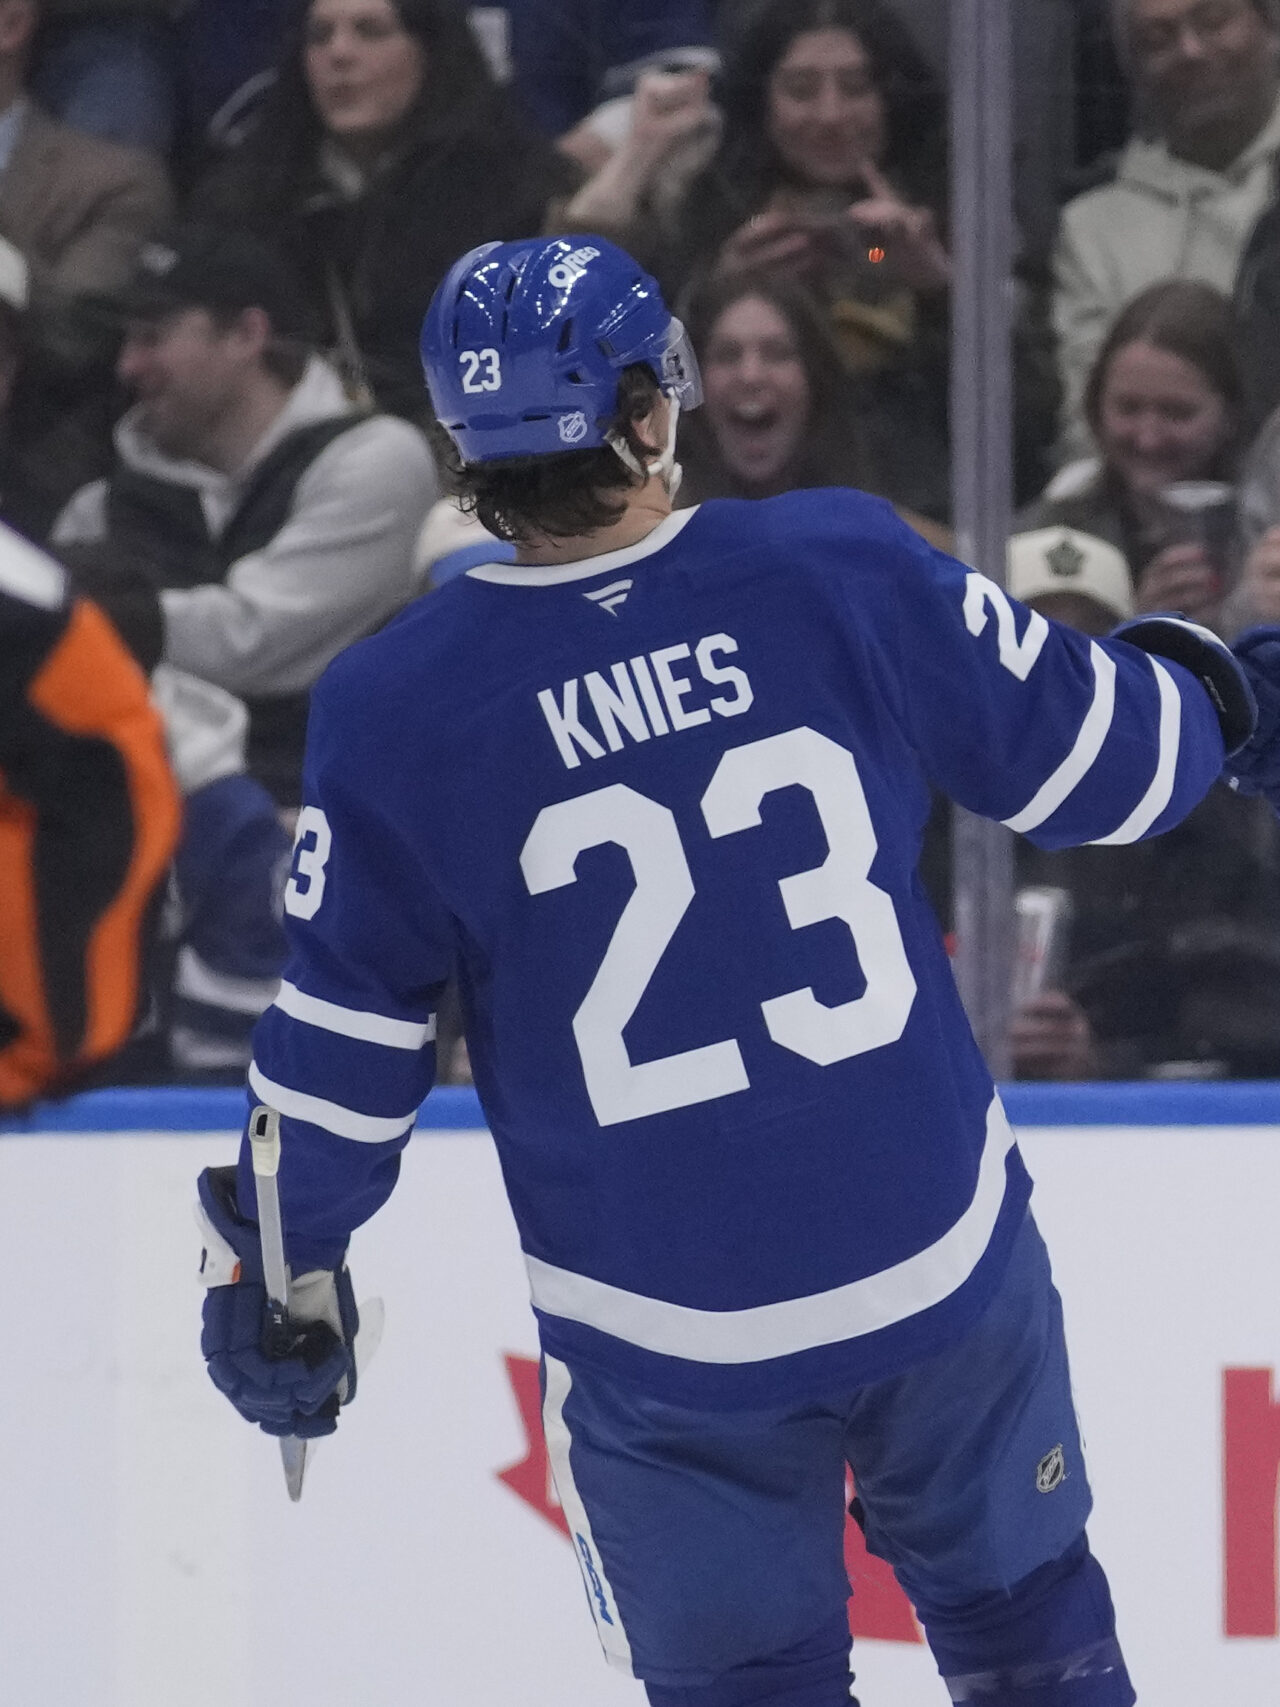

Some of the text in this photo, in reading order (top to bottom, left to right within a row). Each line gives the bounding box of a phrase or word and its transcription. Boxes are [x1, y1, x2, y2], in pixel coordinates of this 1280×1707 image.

[459, 348, 502, 394] 23
[537, 632, 754, 769] KNIES
[519, 725, 918, 1127] 23
